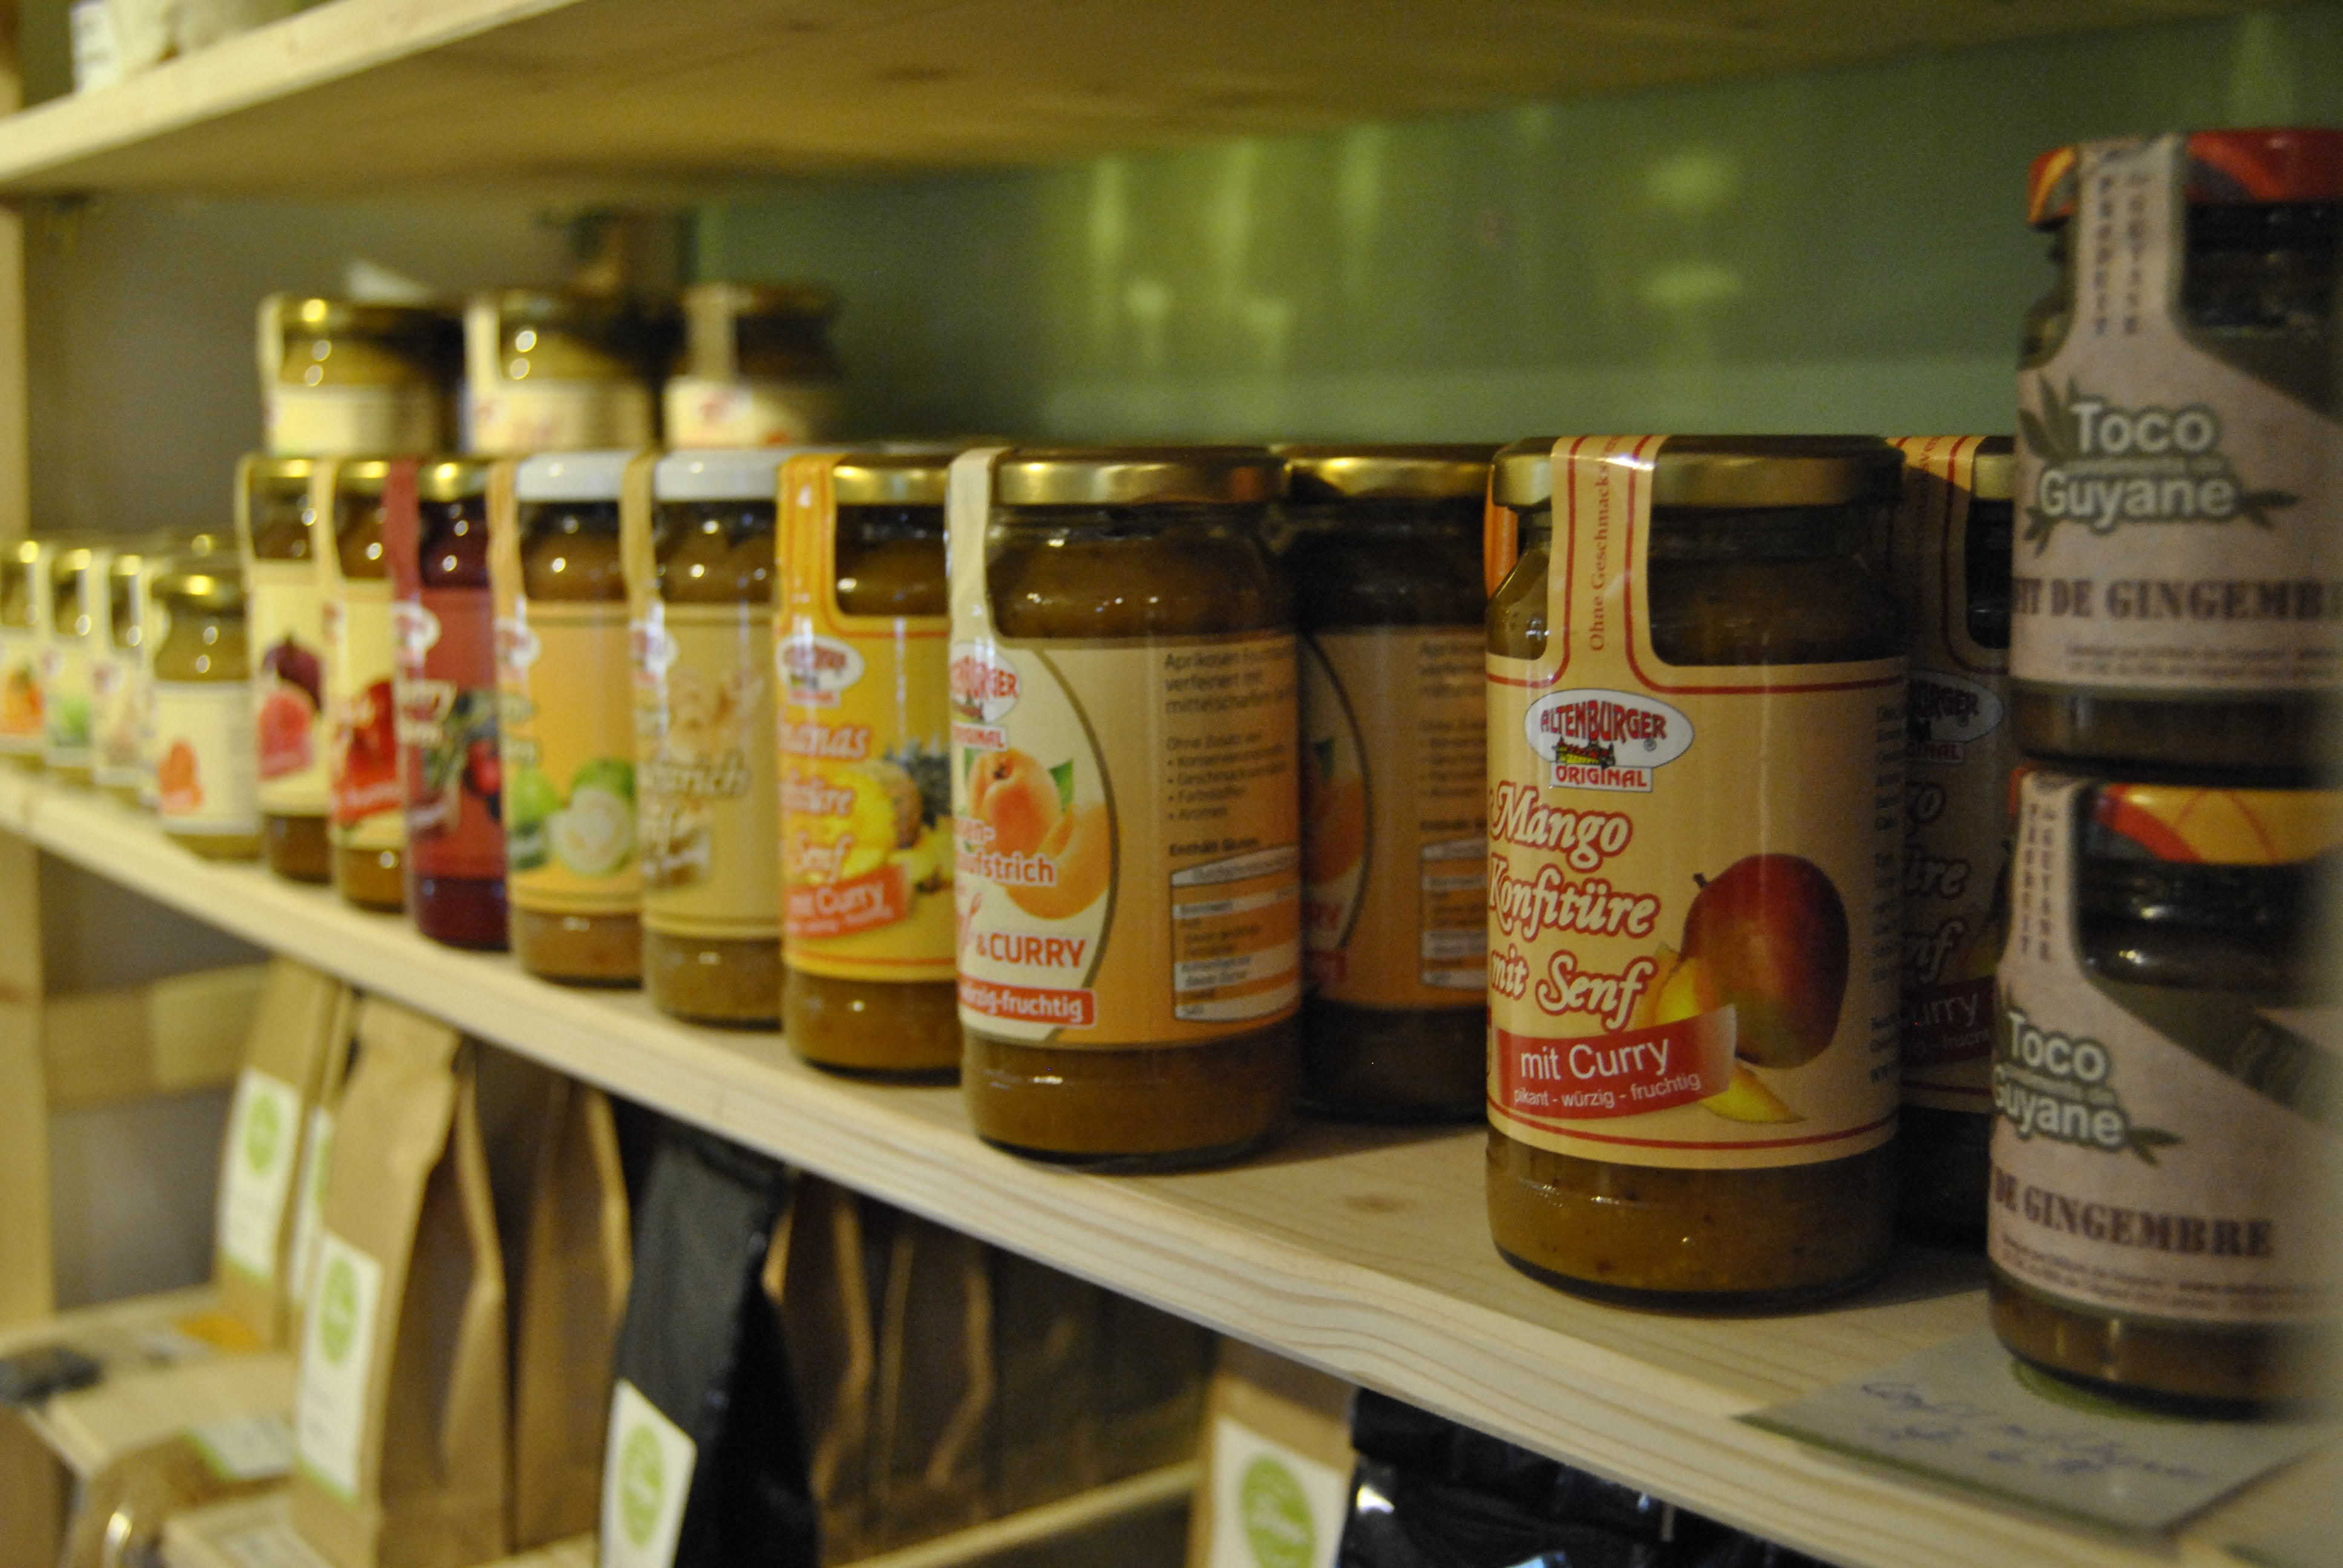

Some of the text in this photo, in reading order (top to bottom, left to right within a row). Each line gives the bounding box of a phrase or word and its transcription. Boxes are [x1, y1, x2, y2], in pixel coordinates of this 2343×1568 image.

[2069, 402, 2217, 454] Toco
[2039, 469, 2238, 530] Guyane
[1589, 596, 1605, 652] Ohne
[1540, 700, 1666, 743] ALTENBURGER
[1556, 766, 1647, 787] ORIGINAL
[1490, 782, 1633, 872] Mango
[1489, 854, 1661, 942] Konfitüre
[991, 933, 1087, 968] CURRY
[1490, 944, 1659, 1030] mit Senf
[1521, 1038, 1670, 1080] mit Curry
[2008, 1010, 2107, 1082] Toco
[1561, 1088, 1615, 1109] würzig
[1630, 1073, 1702, 1101] fruchtig
[2024, 1184, 2275, 1258] GINGEMBRE
